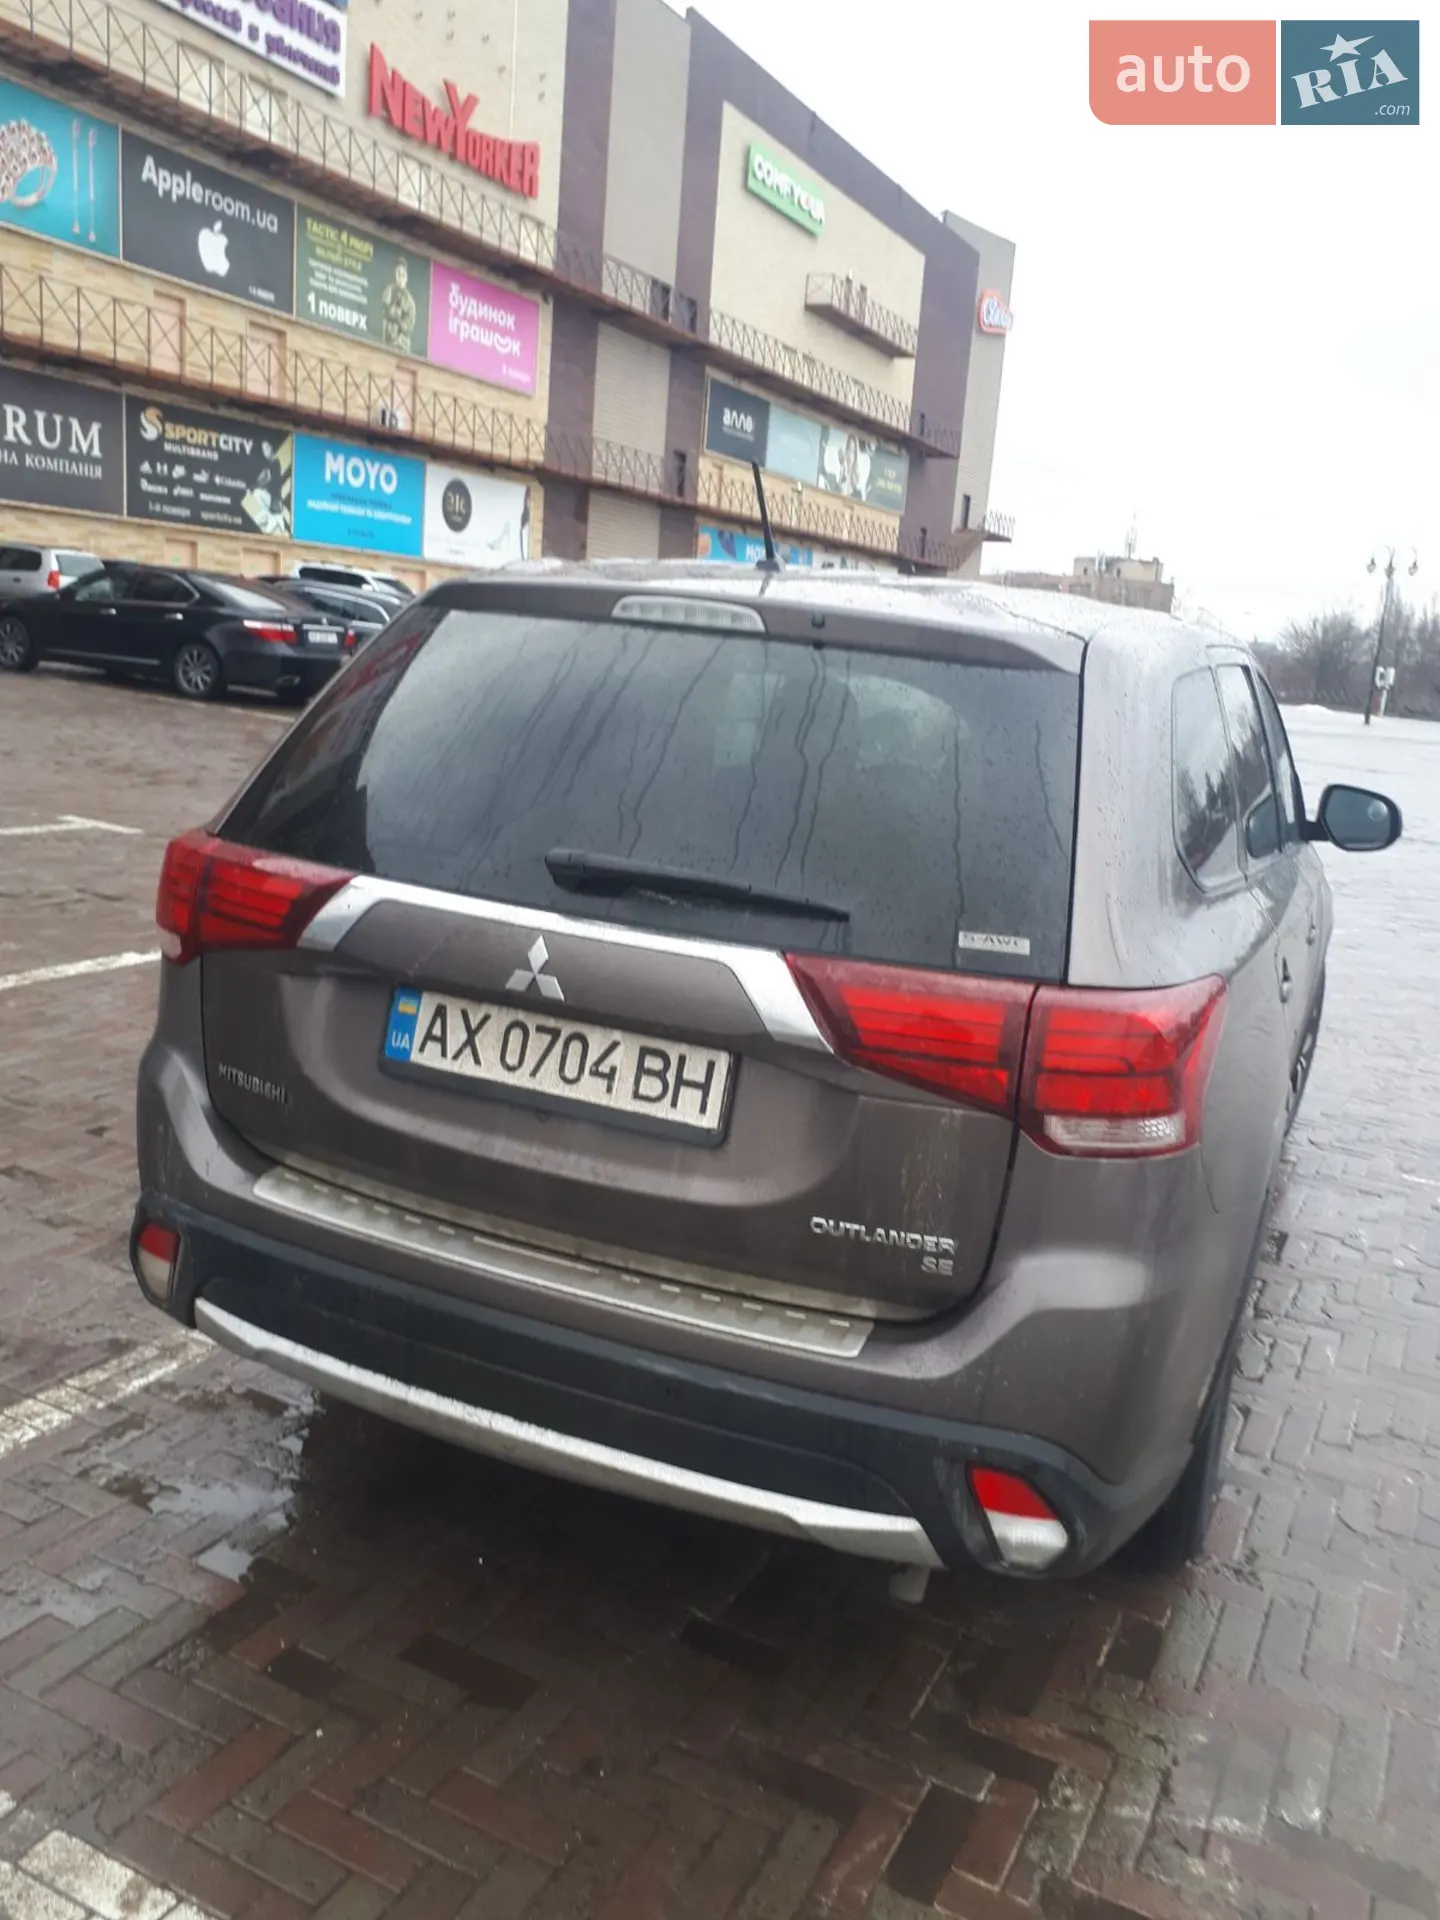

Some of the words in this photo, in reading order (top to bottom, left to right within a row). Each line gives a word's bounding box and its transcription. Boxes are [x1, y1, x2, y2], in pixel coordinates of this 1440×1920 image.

[140, 154, 278, 234] Appleroom.ua
[307, 290, 316, 315] 1
[3, 403, 103, 459] RUM
[164, 421, 254, 456] SPORTCITY
[324, 449, 398, 496] MOYO
[391, 1029, 410, 1051] UA
[418, 1003, 492, 1068] AX
[499, 1020, 621, 1095] 0704
[631, 1045, 716, 1115] BH
[218, 1062, 286, 1105] MITSUBISHI
[809, 1215, 955, 1256] OUTLANDER
[920, 1256, 954, 1276] SE
